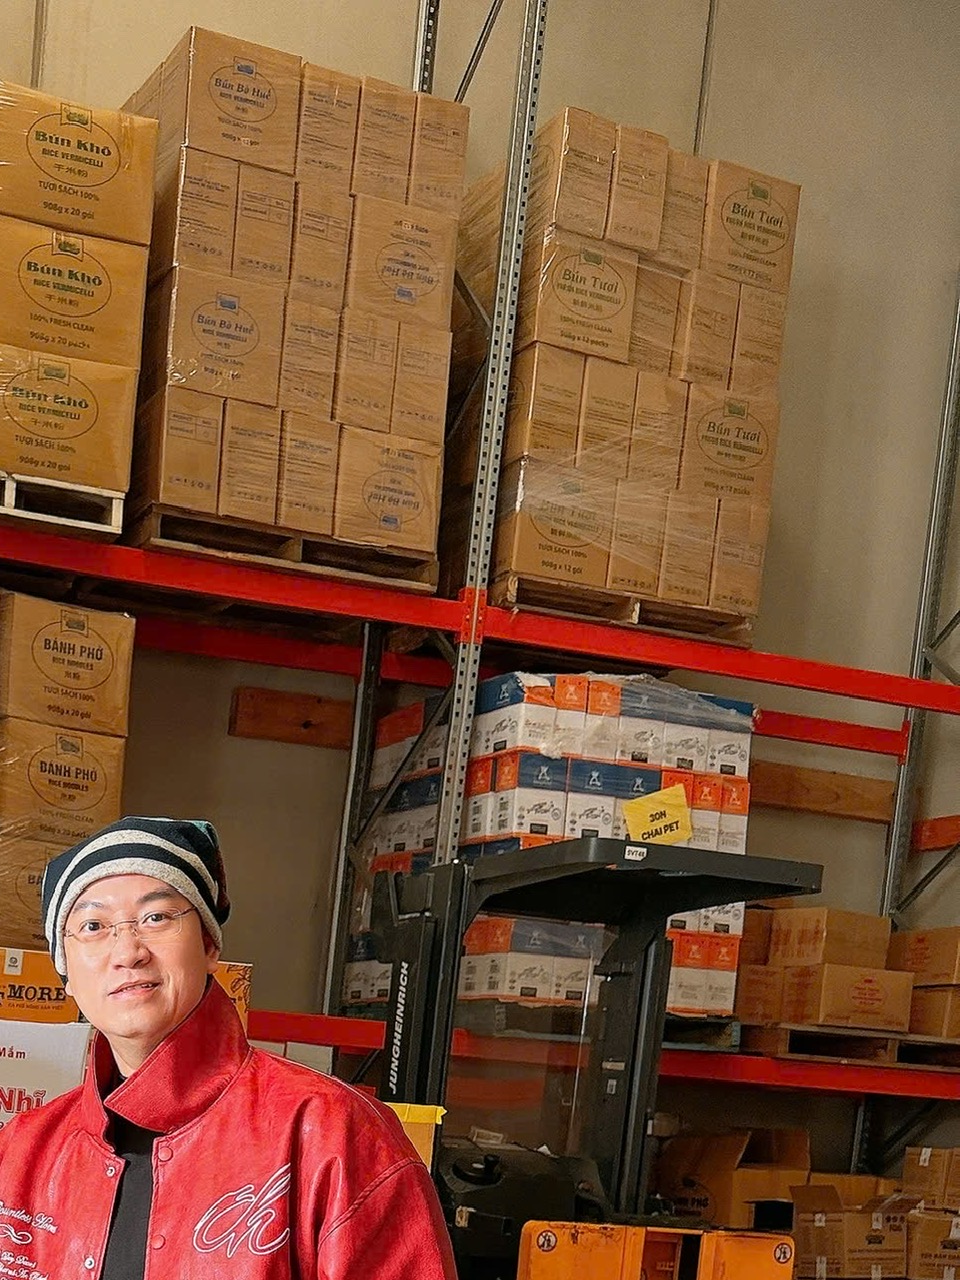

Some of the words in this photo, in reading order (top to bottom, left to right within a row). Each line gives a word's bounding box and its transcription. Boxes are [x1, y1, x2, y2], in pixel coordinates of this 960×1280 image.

[35, 130, 71, 147] Bún
[76, 139, 112, 156] Khô
[70, 207, 80, 215] 20
[26, 261, 62, 277] Bún
[68, 269, 103, 286] Khô
[43, 637, 76, 655] BÁNH
[663, 820, 680, 834] PET
[6, 984, 68, 1001] MORE
[388, 961, 409, 1095] JUNGHEINRICH
